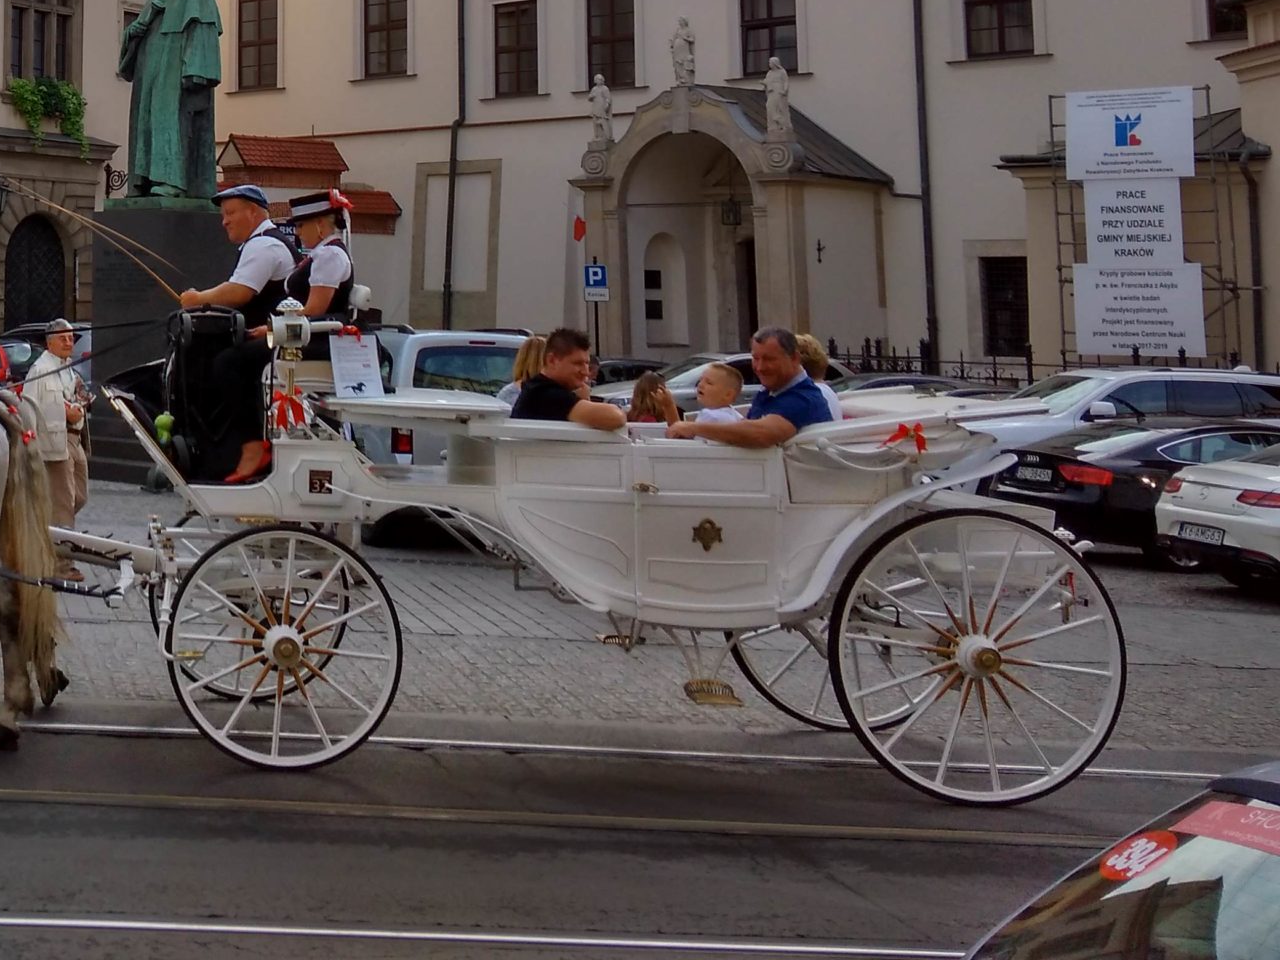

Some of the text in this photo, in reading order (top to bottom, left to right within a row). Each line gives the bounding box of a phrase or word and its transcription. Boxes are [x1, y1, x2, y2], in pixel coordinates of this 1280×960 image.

[1116, 190, 1146, 199] PRACE
[1100, 205, 1165, 214] FINANSOWANE
[1102, 220, 1165, 228] PRZY UDZIALE
[1096, 234, 1172, 243] GMINY MIEJSKIEJ
[1114, 246, 1154, 257] KRAKÓW
[589, 268, 602, 285] P
[312, 480, 328, 492] 32
